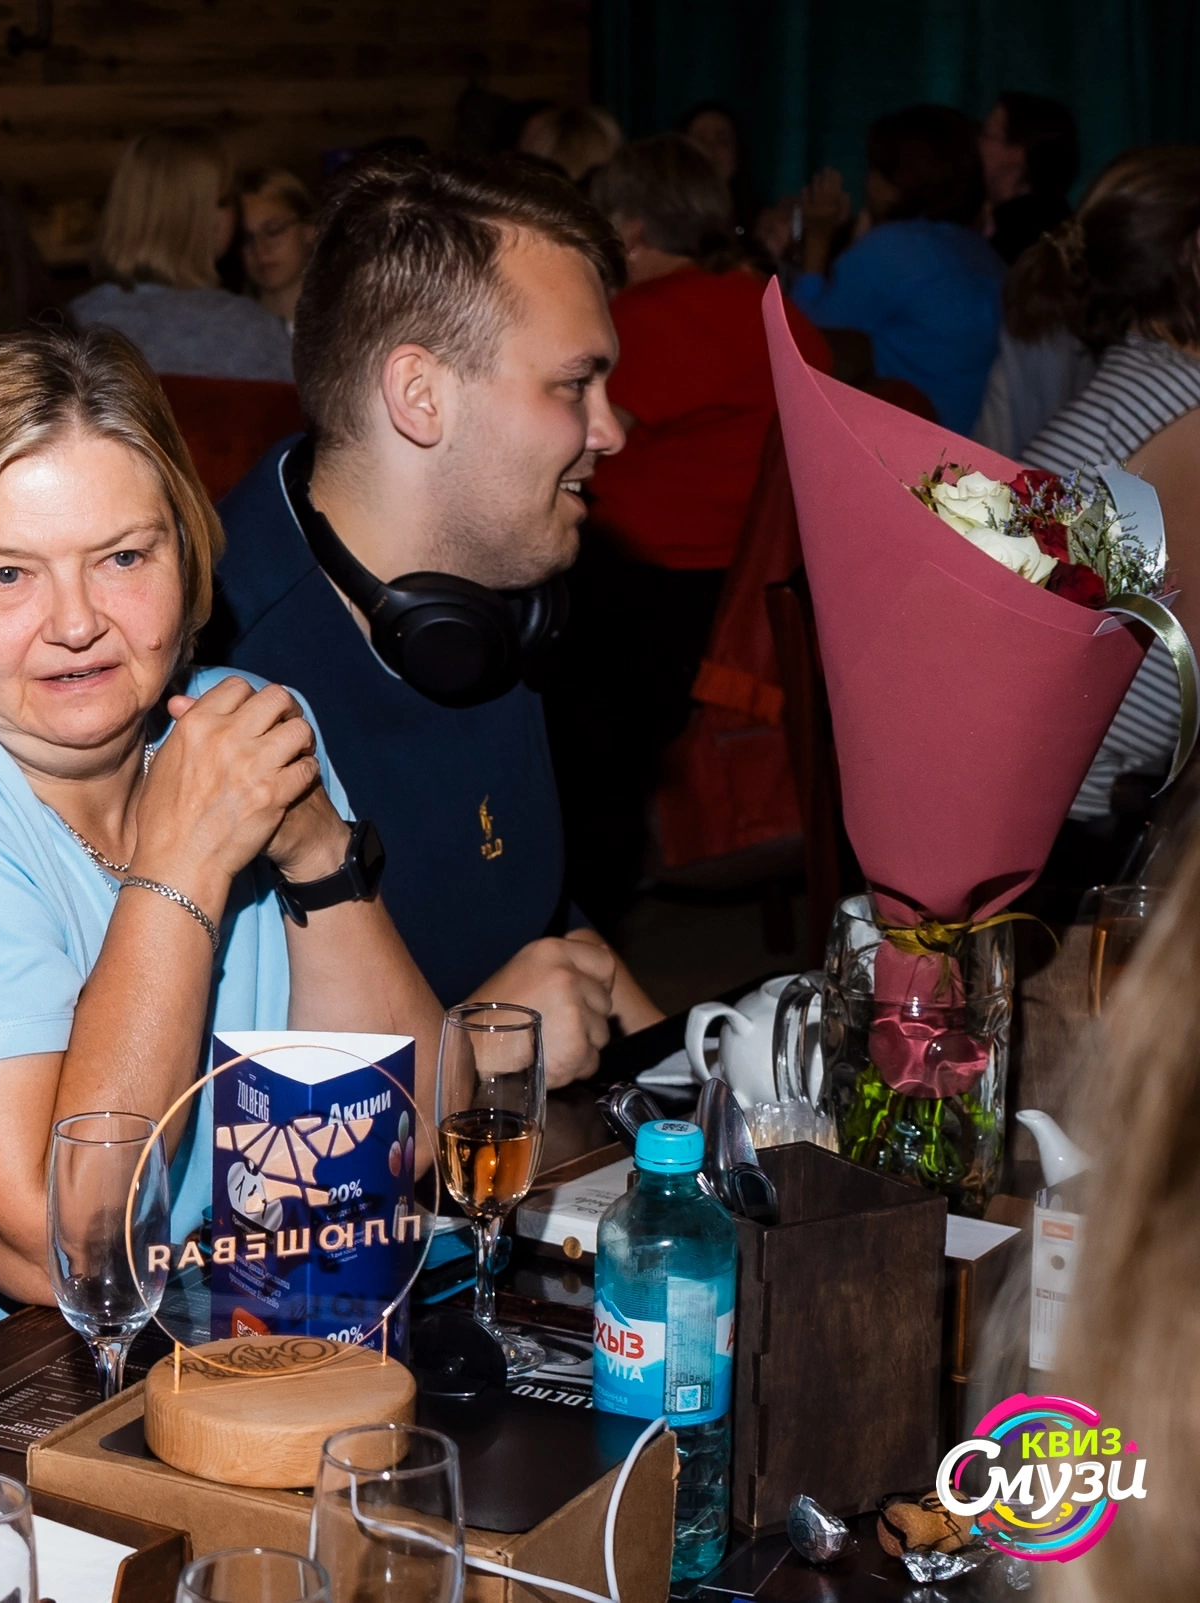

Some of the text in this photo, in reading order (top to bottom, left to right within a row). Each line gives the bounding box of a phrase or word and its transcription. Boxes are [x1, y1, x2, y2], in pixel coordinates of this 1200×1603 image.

[237, 1079, 270, 1123] ZOLBERG
[327, 1089, 392, 1127] Акции
[606, 1356, 644, 1383] VITA
[14, 1422, 51, 1434] ИТКИ
